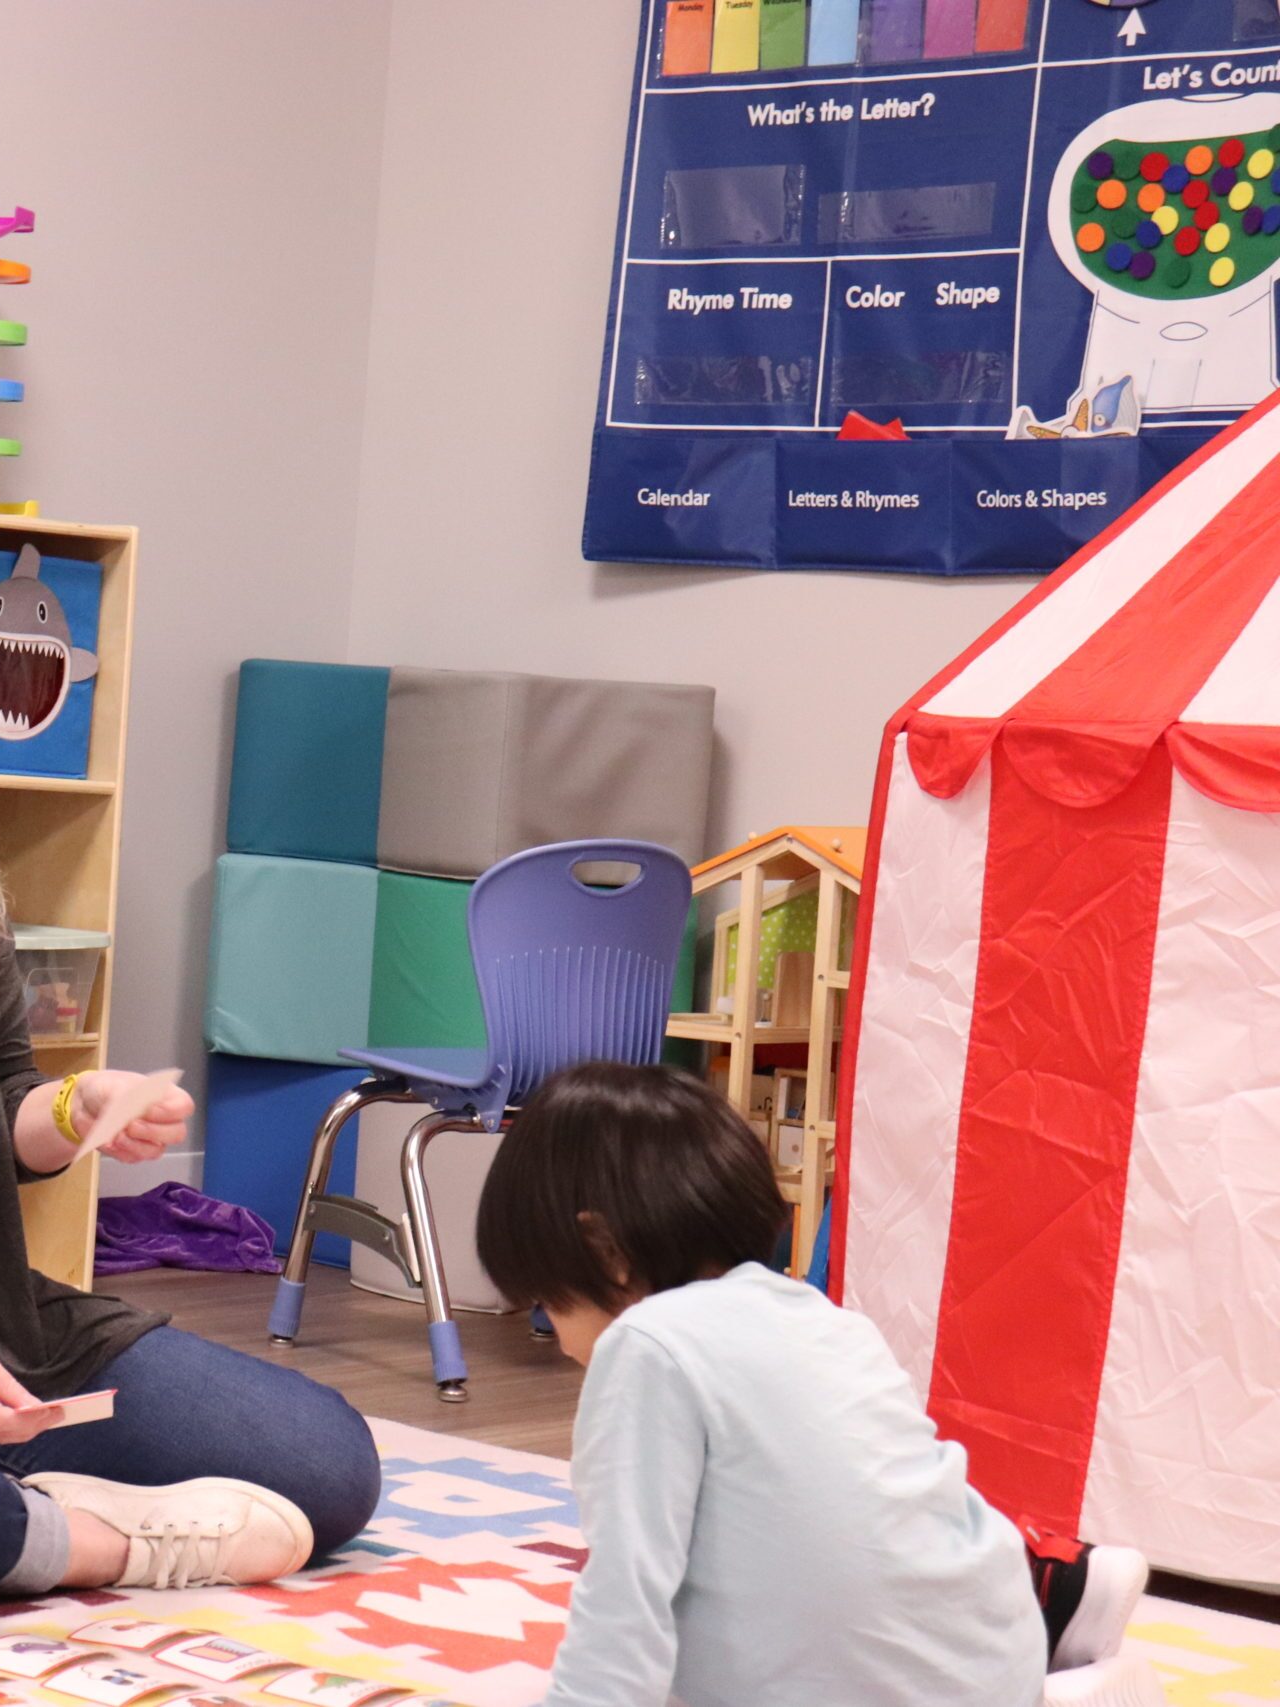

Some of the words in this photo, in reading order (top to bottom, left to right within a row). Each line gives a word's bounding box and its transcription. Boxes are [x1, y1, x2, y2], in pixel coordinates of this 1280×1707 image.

[725, 1, 753, 9] Tuesday
[1143, 64, 1203, 90] Let's
[747, 101, 815, 127] What's
[819, 98, 854, 122] the
[860, 92, 936, 120] Letter?
[667, 287, 735, 315] Rhyme
[739, 286, 793, 310] Time
[845, 284, 906, 309] Color
[935, 281, 1001, 309] Shape
[637, 487, 711, 507] Calendar
[788, 490, 838, 508] Letters
[840, 490, 853, 508] &
[855, 490, 920, 512] Rhymes
[976, 489, 1022, 508] Colors
[1024, 489, 1039, 508] &
[1041, 488, 1108, 511] Shapes
